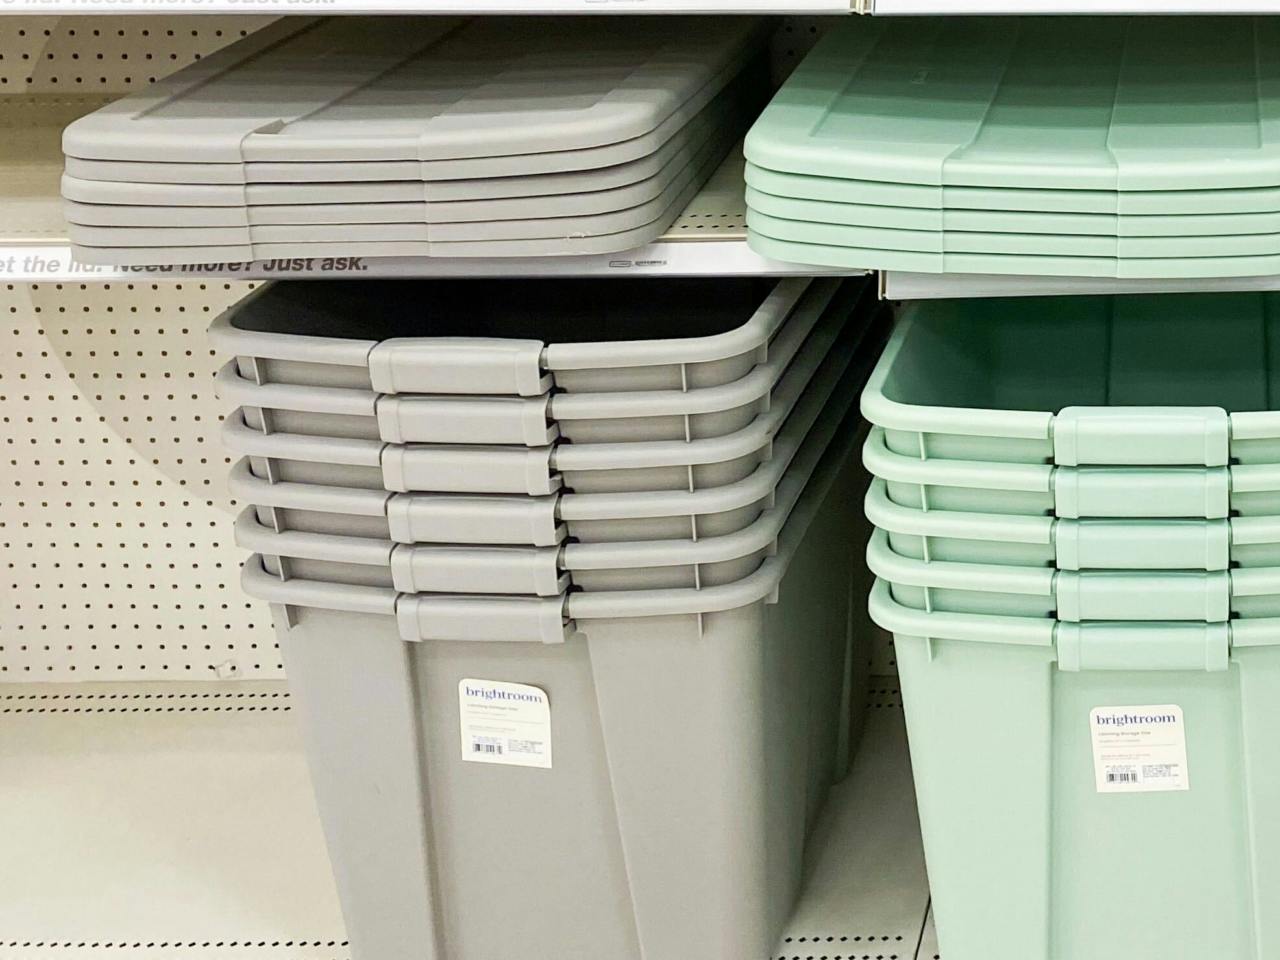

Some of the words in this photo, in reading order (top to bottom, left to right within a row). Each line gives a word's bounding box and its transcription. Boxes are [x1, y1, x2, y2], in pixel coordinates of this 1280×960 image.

[23, 256, 60, 273] the
[263, 257, 313, 272] Just
[321, 256, 368, 271] ask.
[466, 686, 543, 704] brightroom
[1096, 714, 1176, 727] brightroom
